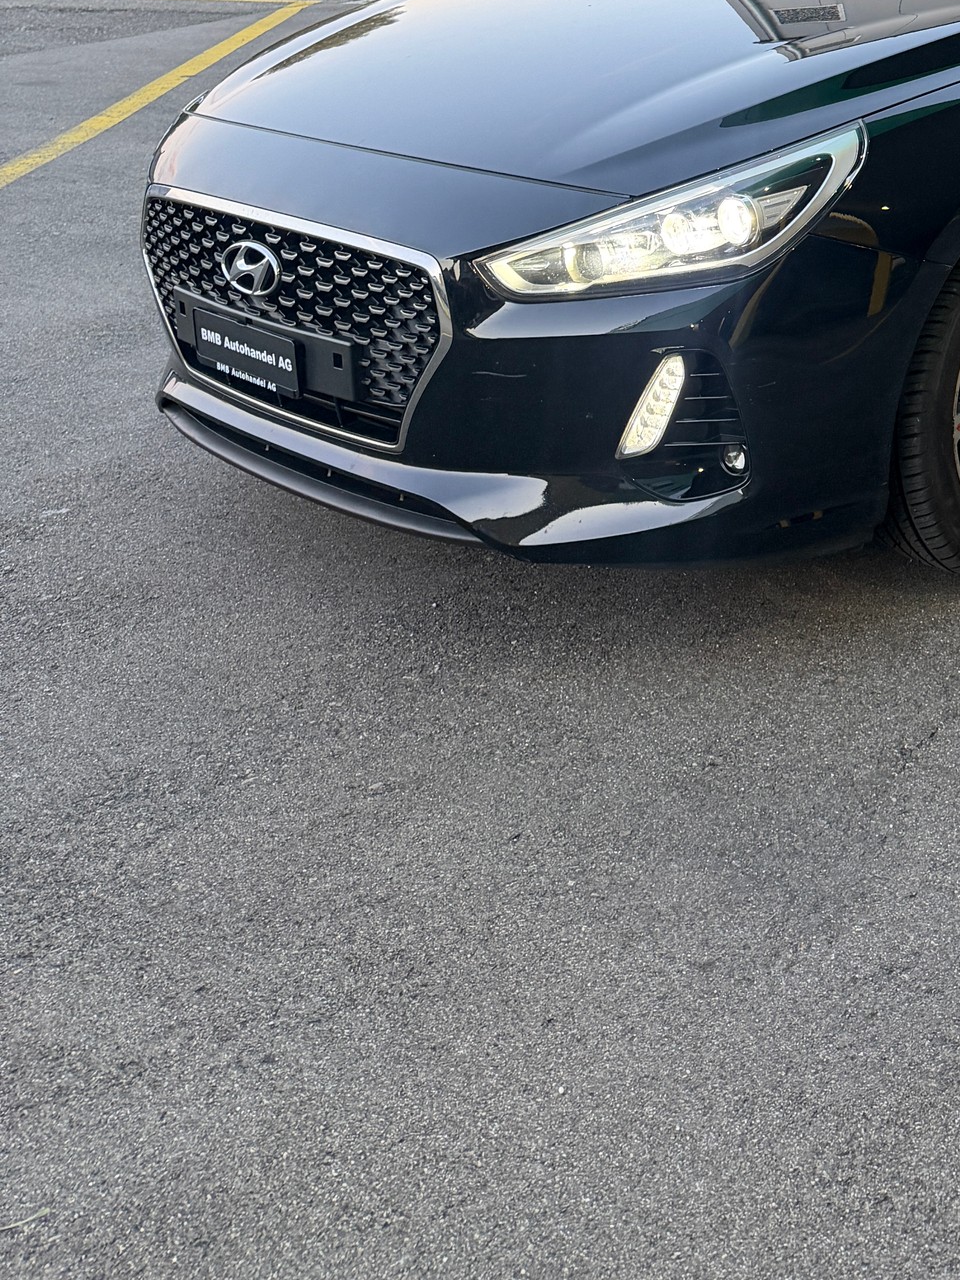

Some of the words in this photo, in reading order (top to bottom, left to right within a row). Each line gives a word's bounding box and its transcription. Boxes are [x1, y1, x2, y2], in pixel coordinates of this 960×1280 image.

[201, 327, 222, 345] BMB
[223, 336, 276, 366] Autohandel
[278, 356, 293, 372] AG
[216, 361, 230, 374] BMB
[231, 368, 266, 388] Autohandel
[267, 381, 277, 392] AG
